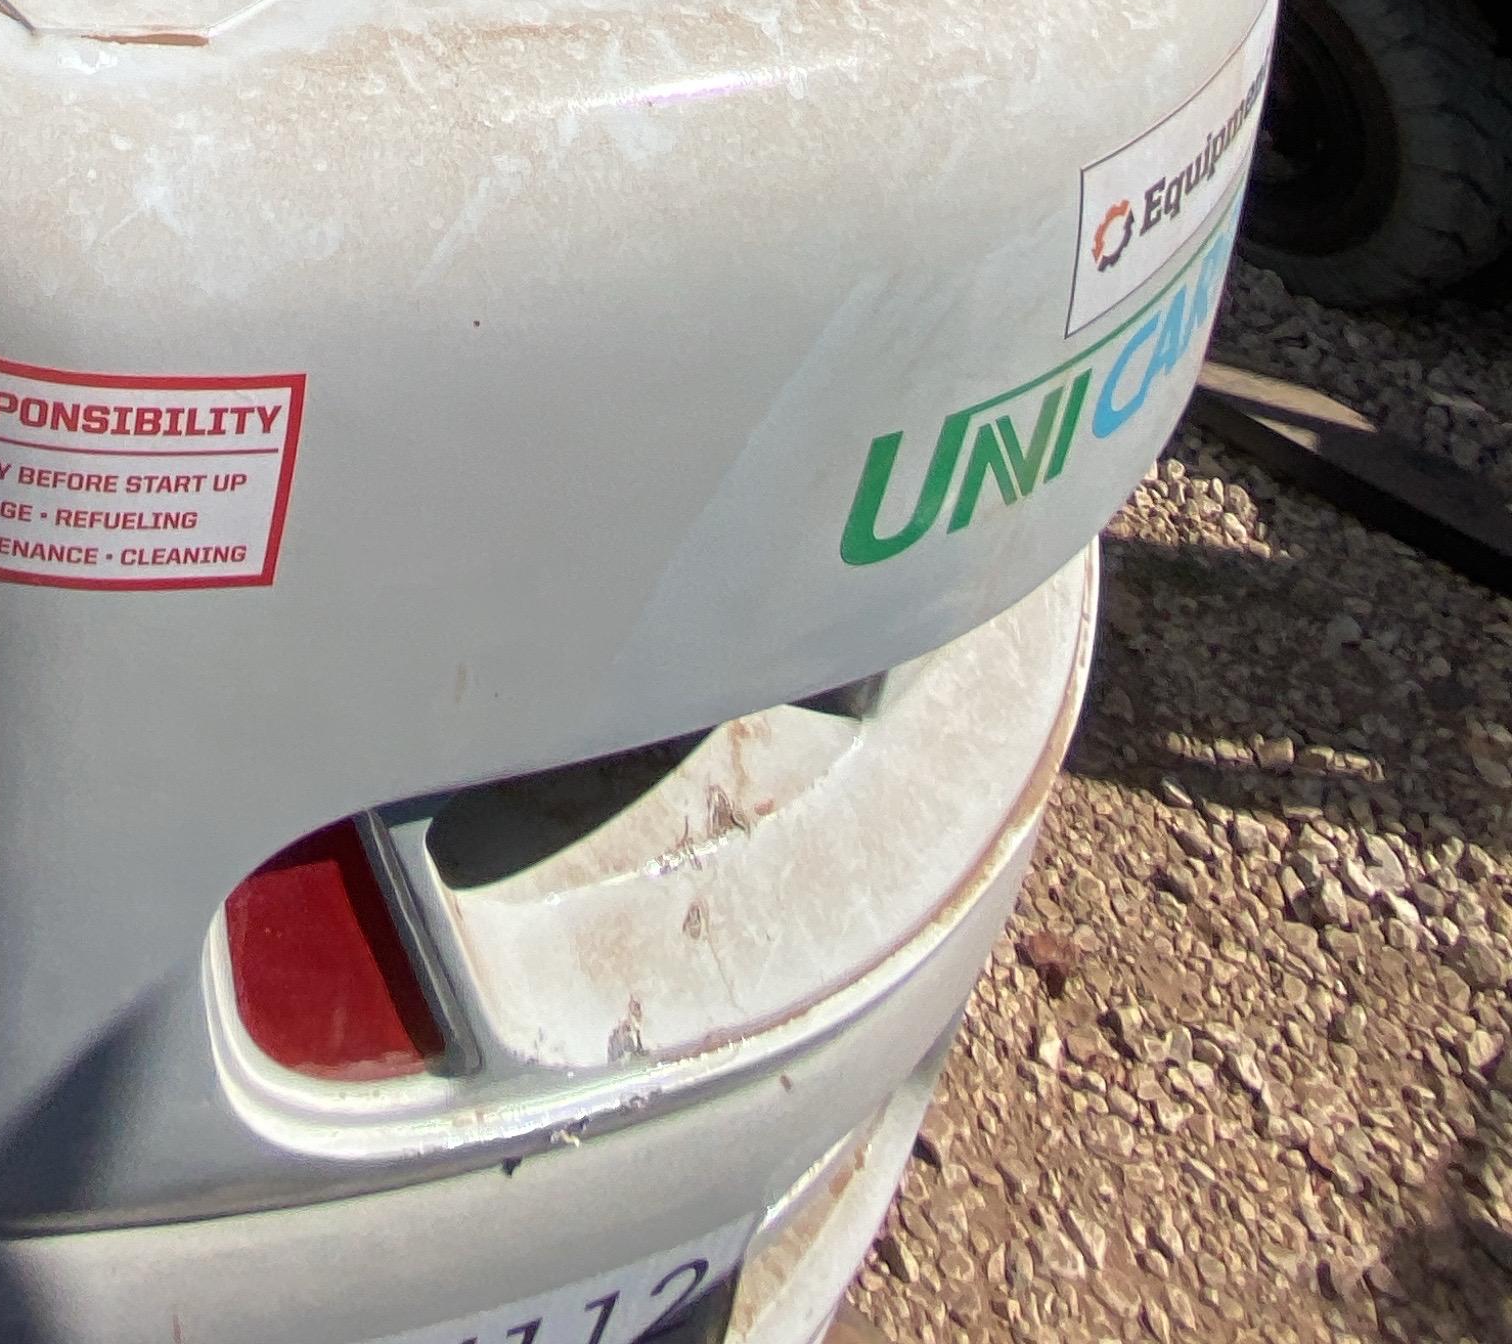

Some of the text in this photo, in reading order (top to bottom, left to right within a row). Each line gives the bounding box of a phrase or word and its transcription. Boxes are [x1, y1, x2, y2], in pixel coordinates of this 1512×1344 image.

[17, 466, 118, 494] BEFORE
[124, 474, 208, 494] START
[212, 472, 248, 493] UP
[54, 507, 199, 531] REFUELING
[119, 543, 248, 567] CLEANING
